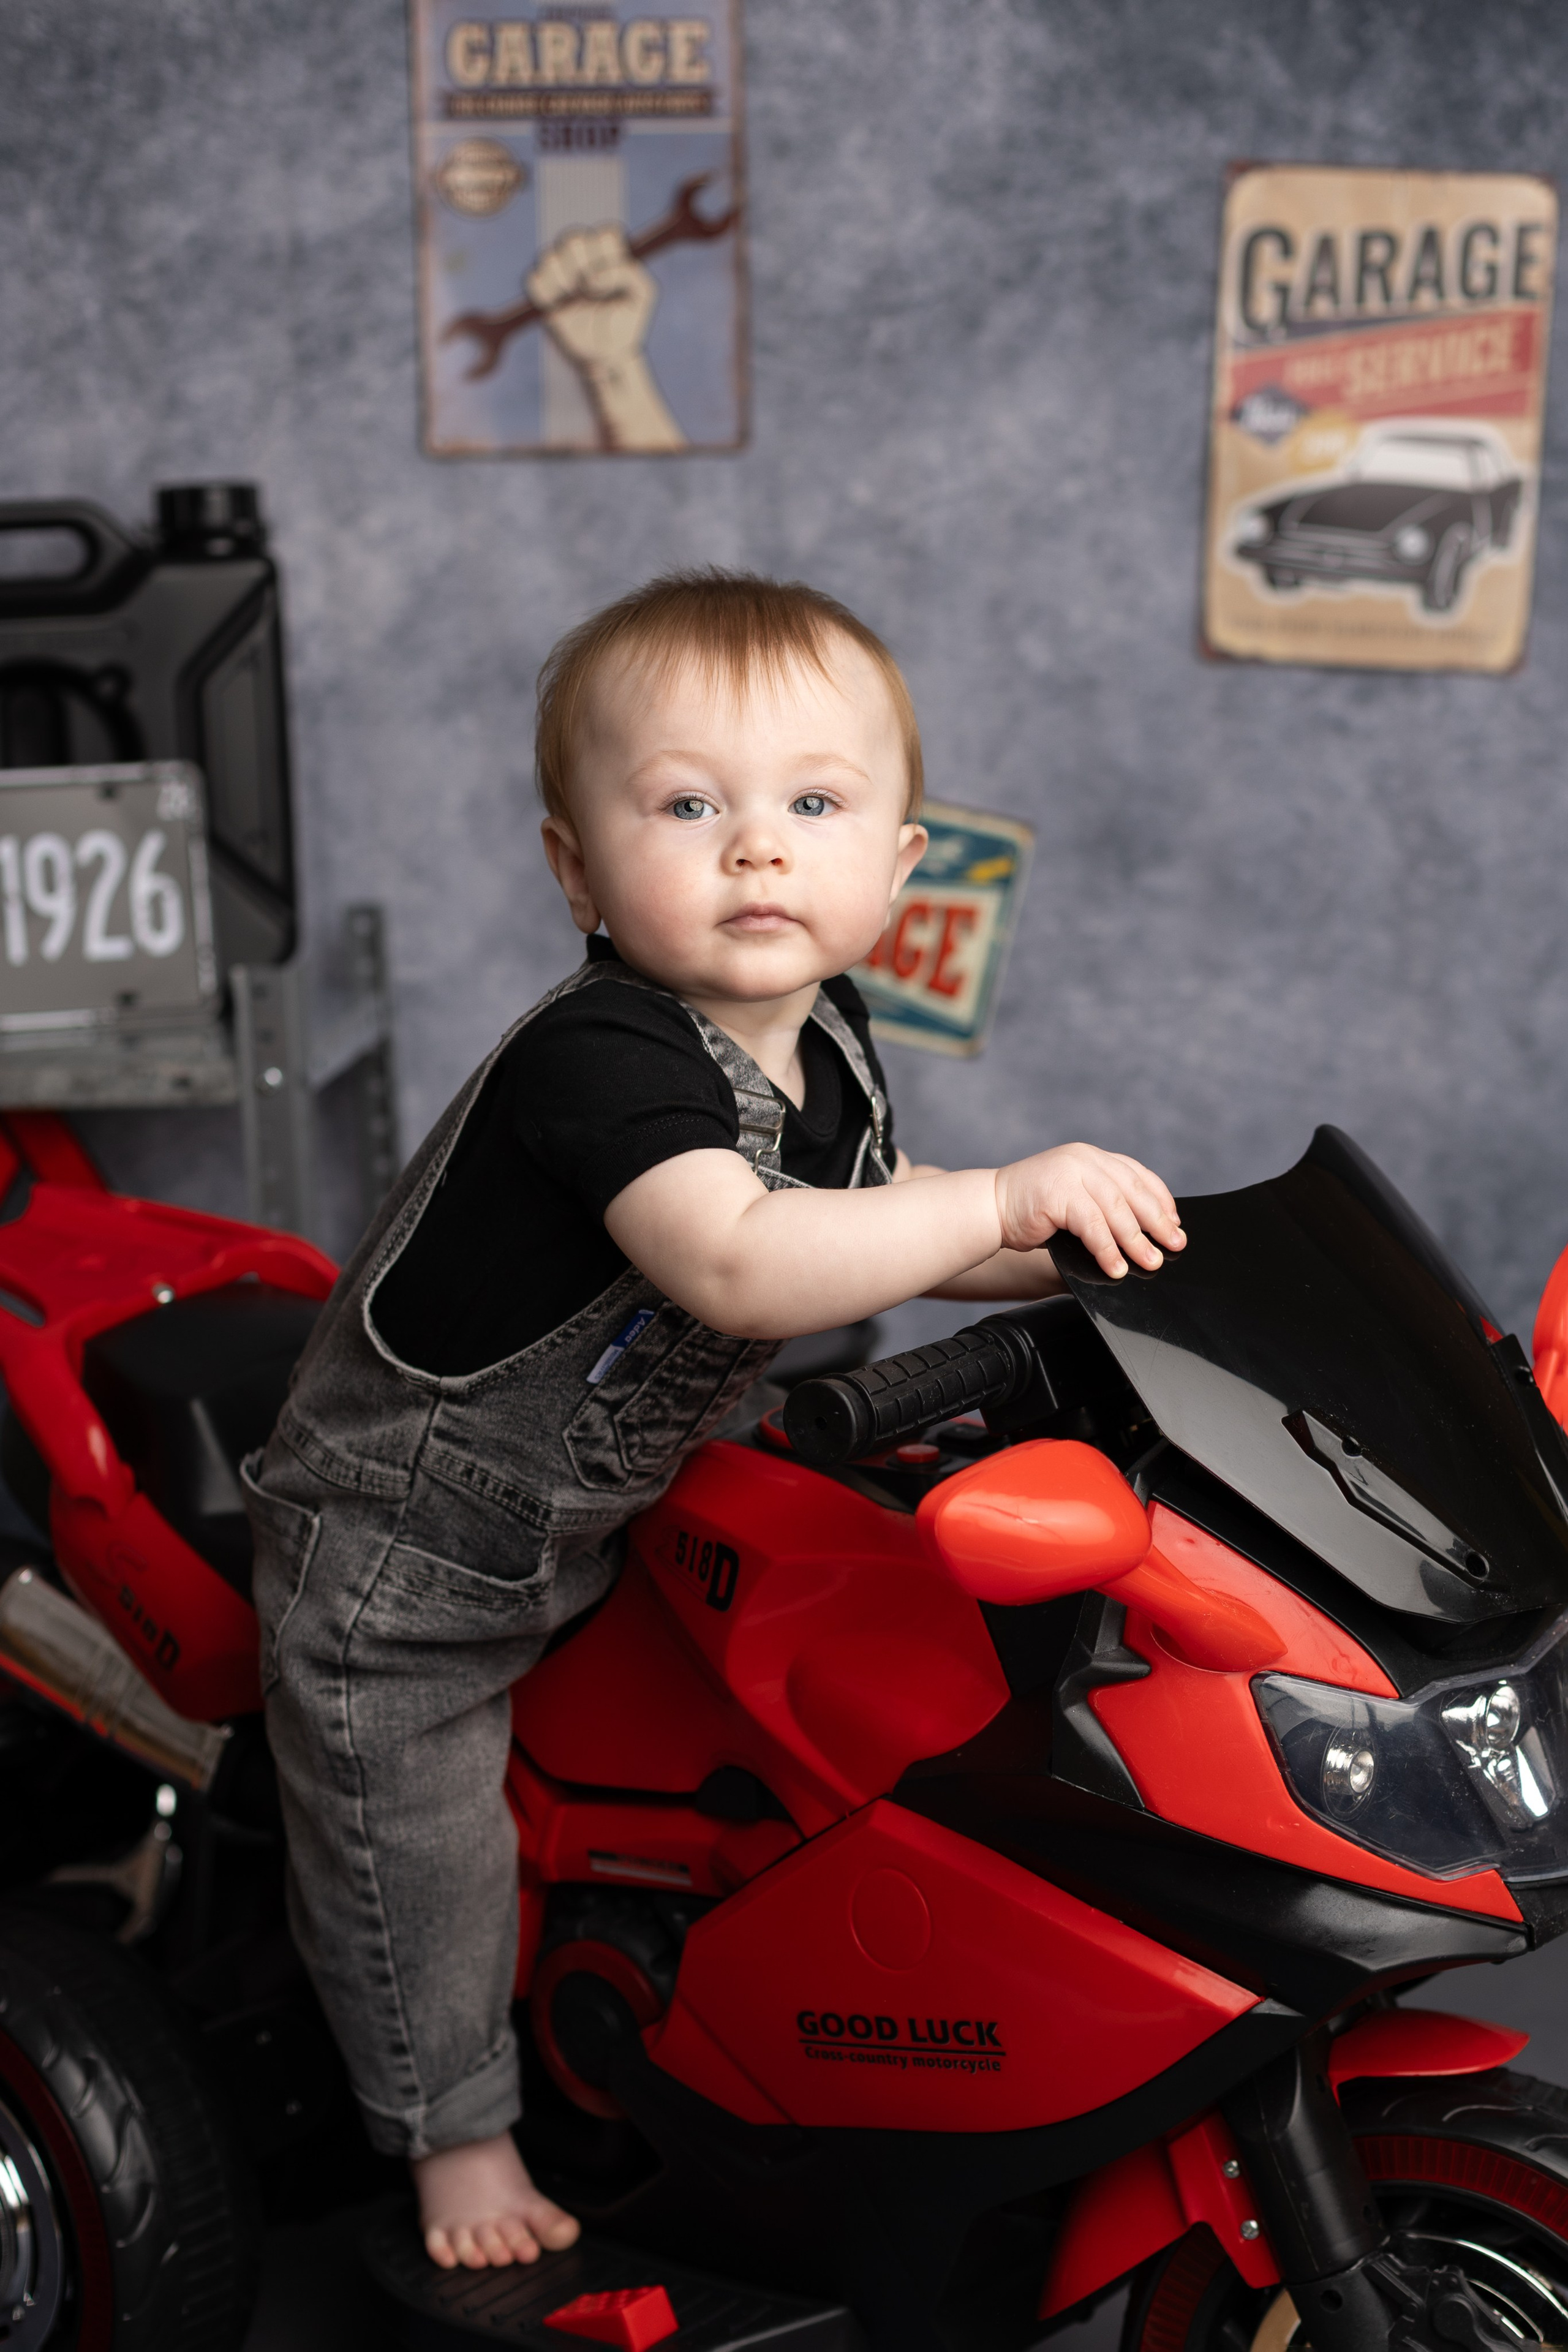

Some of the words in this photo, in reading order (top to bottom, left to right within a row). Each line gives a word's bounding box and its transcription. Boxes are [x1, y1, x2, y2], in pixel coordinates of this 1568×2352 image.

[446, 18, 711, 87] GARAGE
[1238, 223, 1545, 334] GARAGE
[1345, 325, 1513, 399] SERVICE
[0, 828, 184, 967] 1926
[675, 1531, 740, 1612] 518D
[797, 2010, 899, 2041] GOOD
[908, 2018, 1002, 2048] LUCK
[805, 2046, 908, 2070] Cross-country
[912, 2056, 1001, 2075] motorcycle
